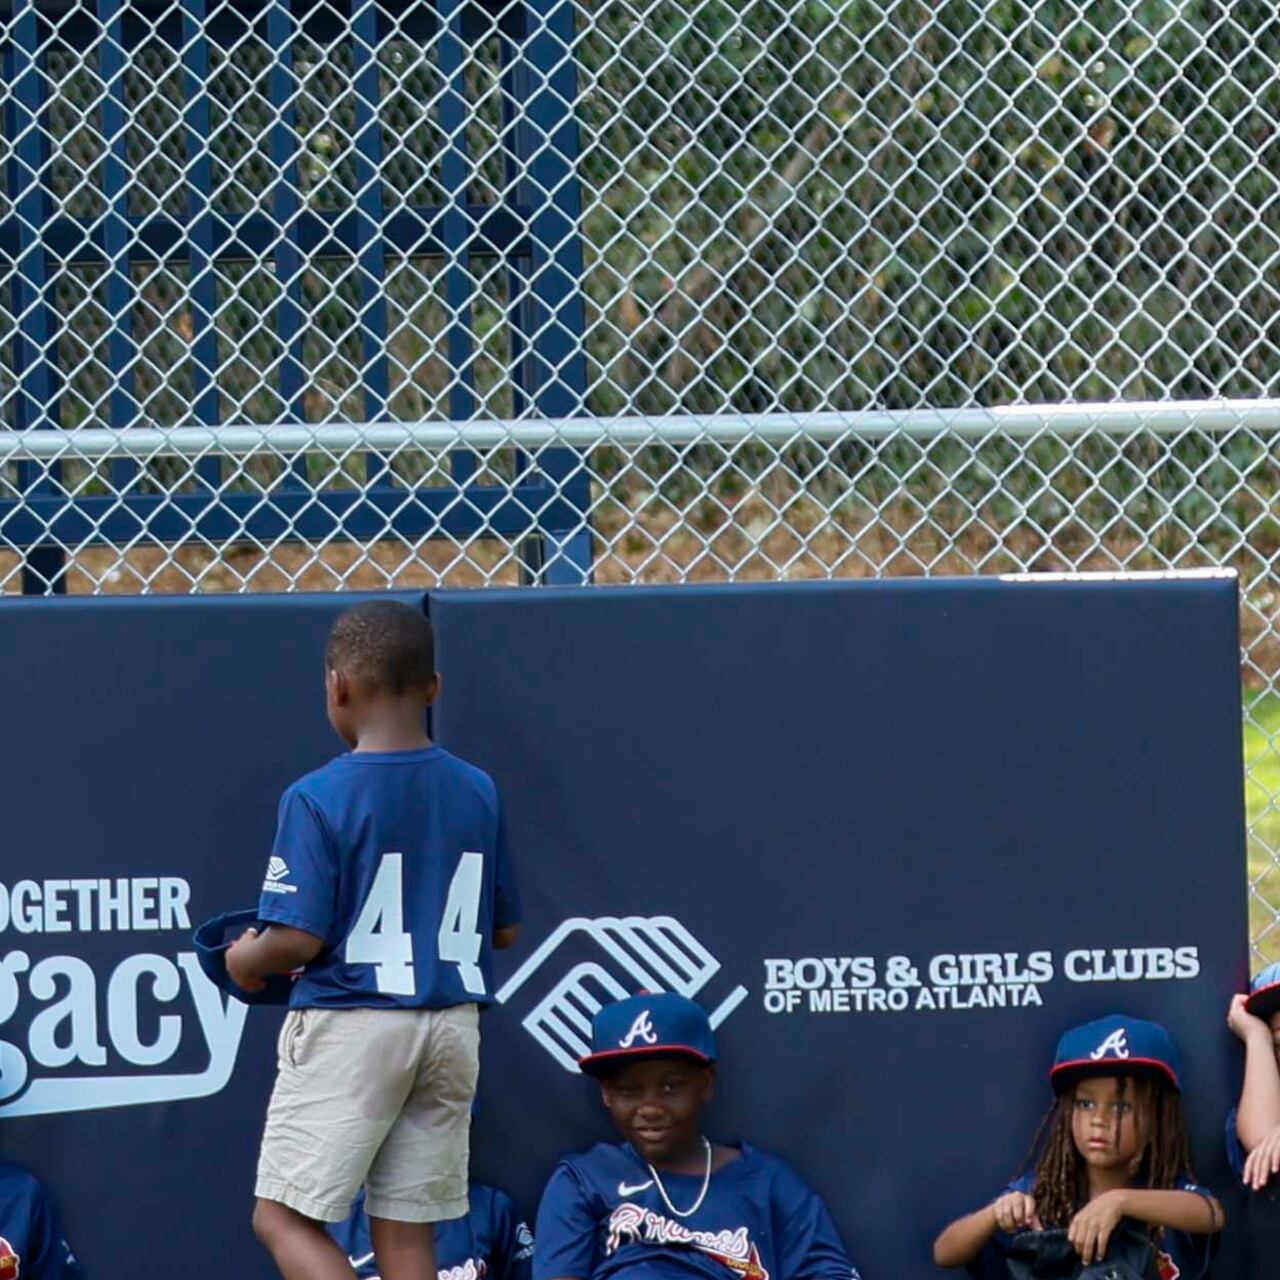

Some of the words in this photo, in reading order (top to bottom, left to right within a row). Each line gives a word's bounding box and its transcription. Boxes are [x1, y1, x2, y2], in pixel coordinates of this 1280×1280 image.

[345, 851, 486, 996] 44
[764, 956, 876, 990] BOYS
[886, 955, 922, 988] &
[929, 951, 1054, 986] GIRLS
[1063, 946, 1200, 982] CLUBS
[764, 989, 802, 1014] OF
[809, 986, 909, 1013] METRO
[915, 983, 1044, 1011] ATLANTA
[618, 1010, 658, 1048] A
[1089, 1028, 1130, 1060] A
